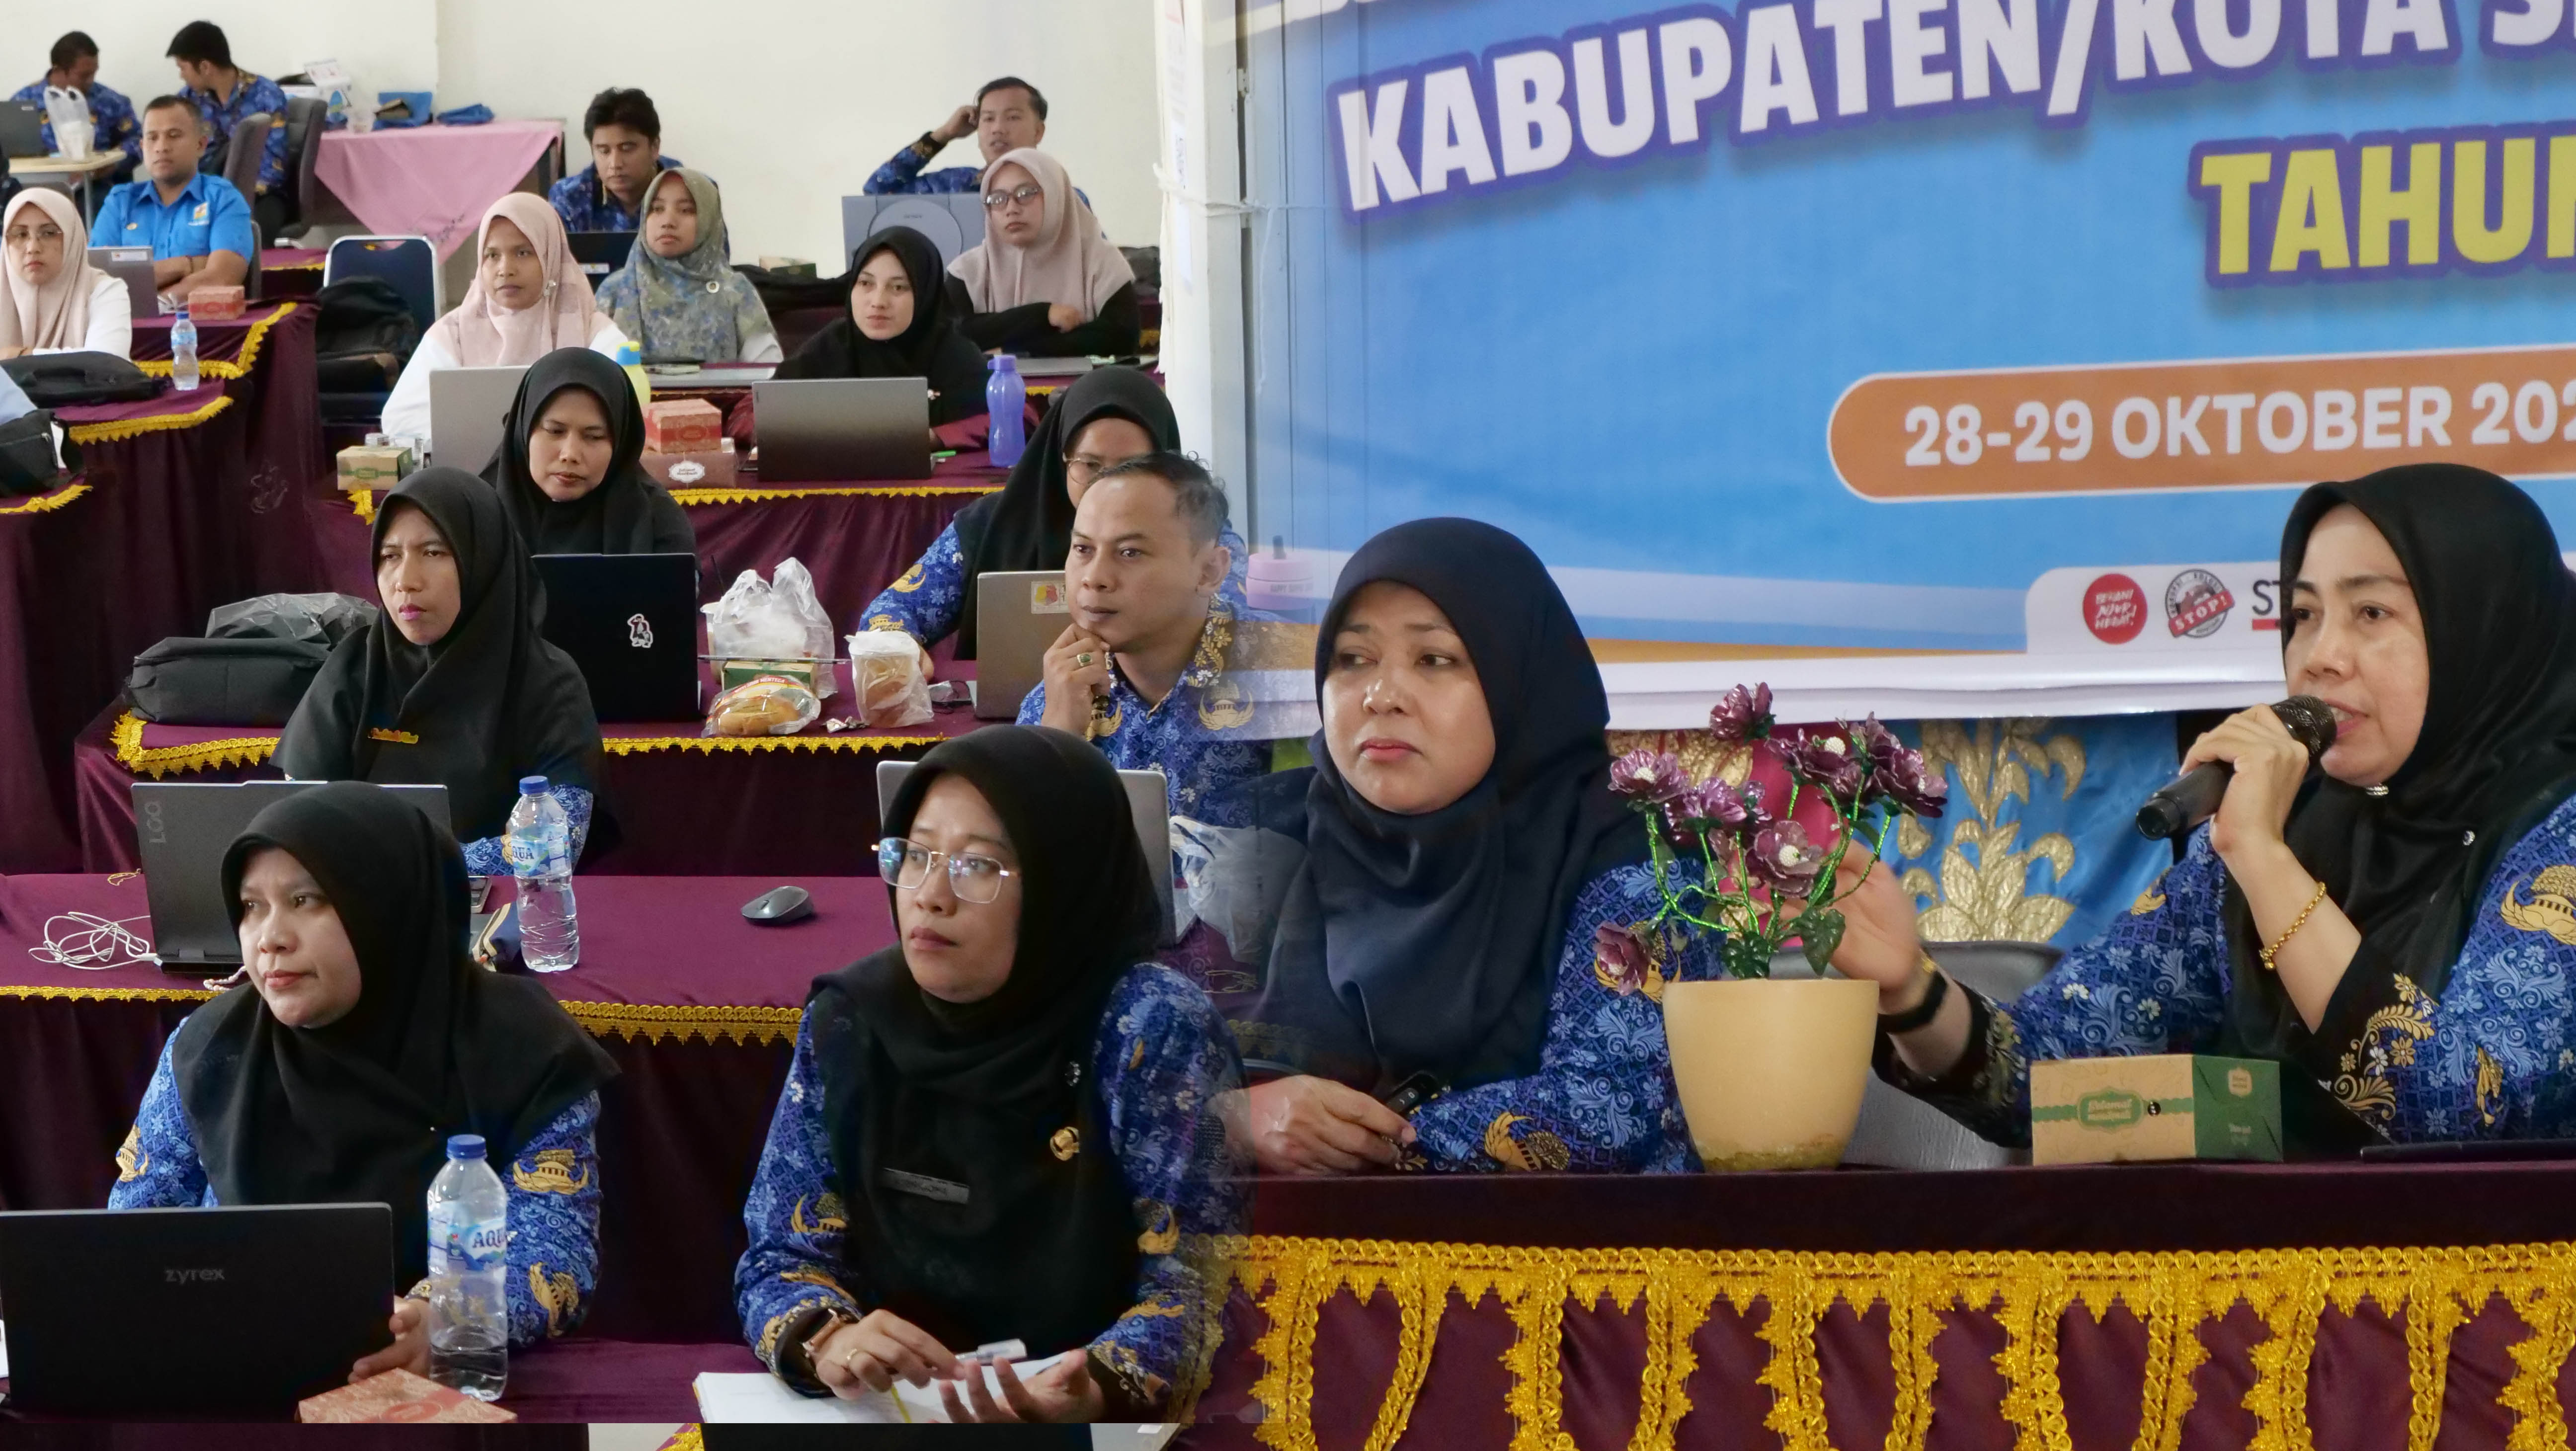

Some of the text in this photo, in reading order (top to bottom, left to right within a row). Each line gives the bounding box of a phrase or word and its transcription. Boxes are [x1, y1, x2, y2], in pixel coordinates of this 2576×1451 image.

[1905, 400, 2093, 466] 28-29
[2111, 386, 2452, 459] OKTOBER
[512, 846, 534, 861] QUA
[473, 1227, 507, 1248] AQU
[164, 1269, 225, 1286] zyrex
